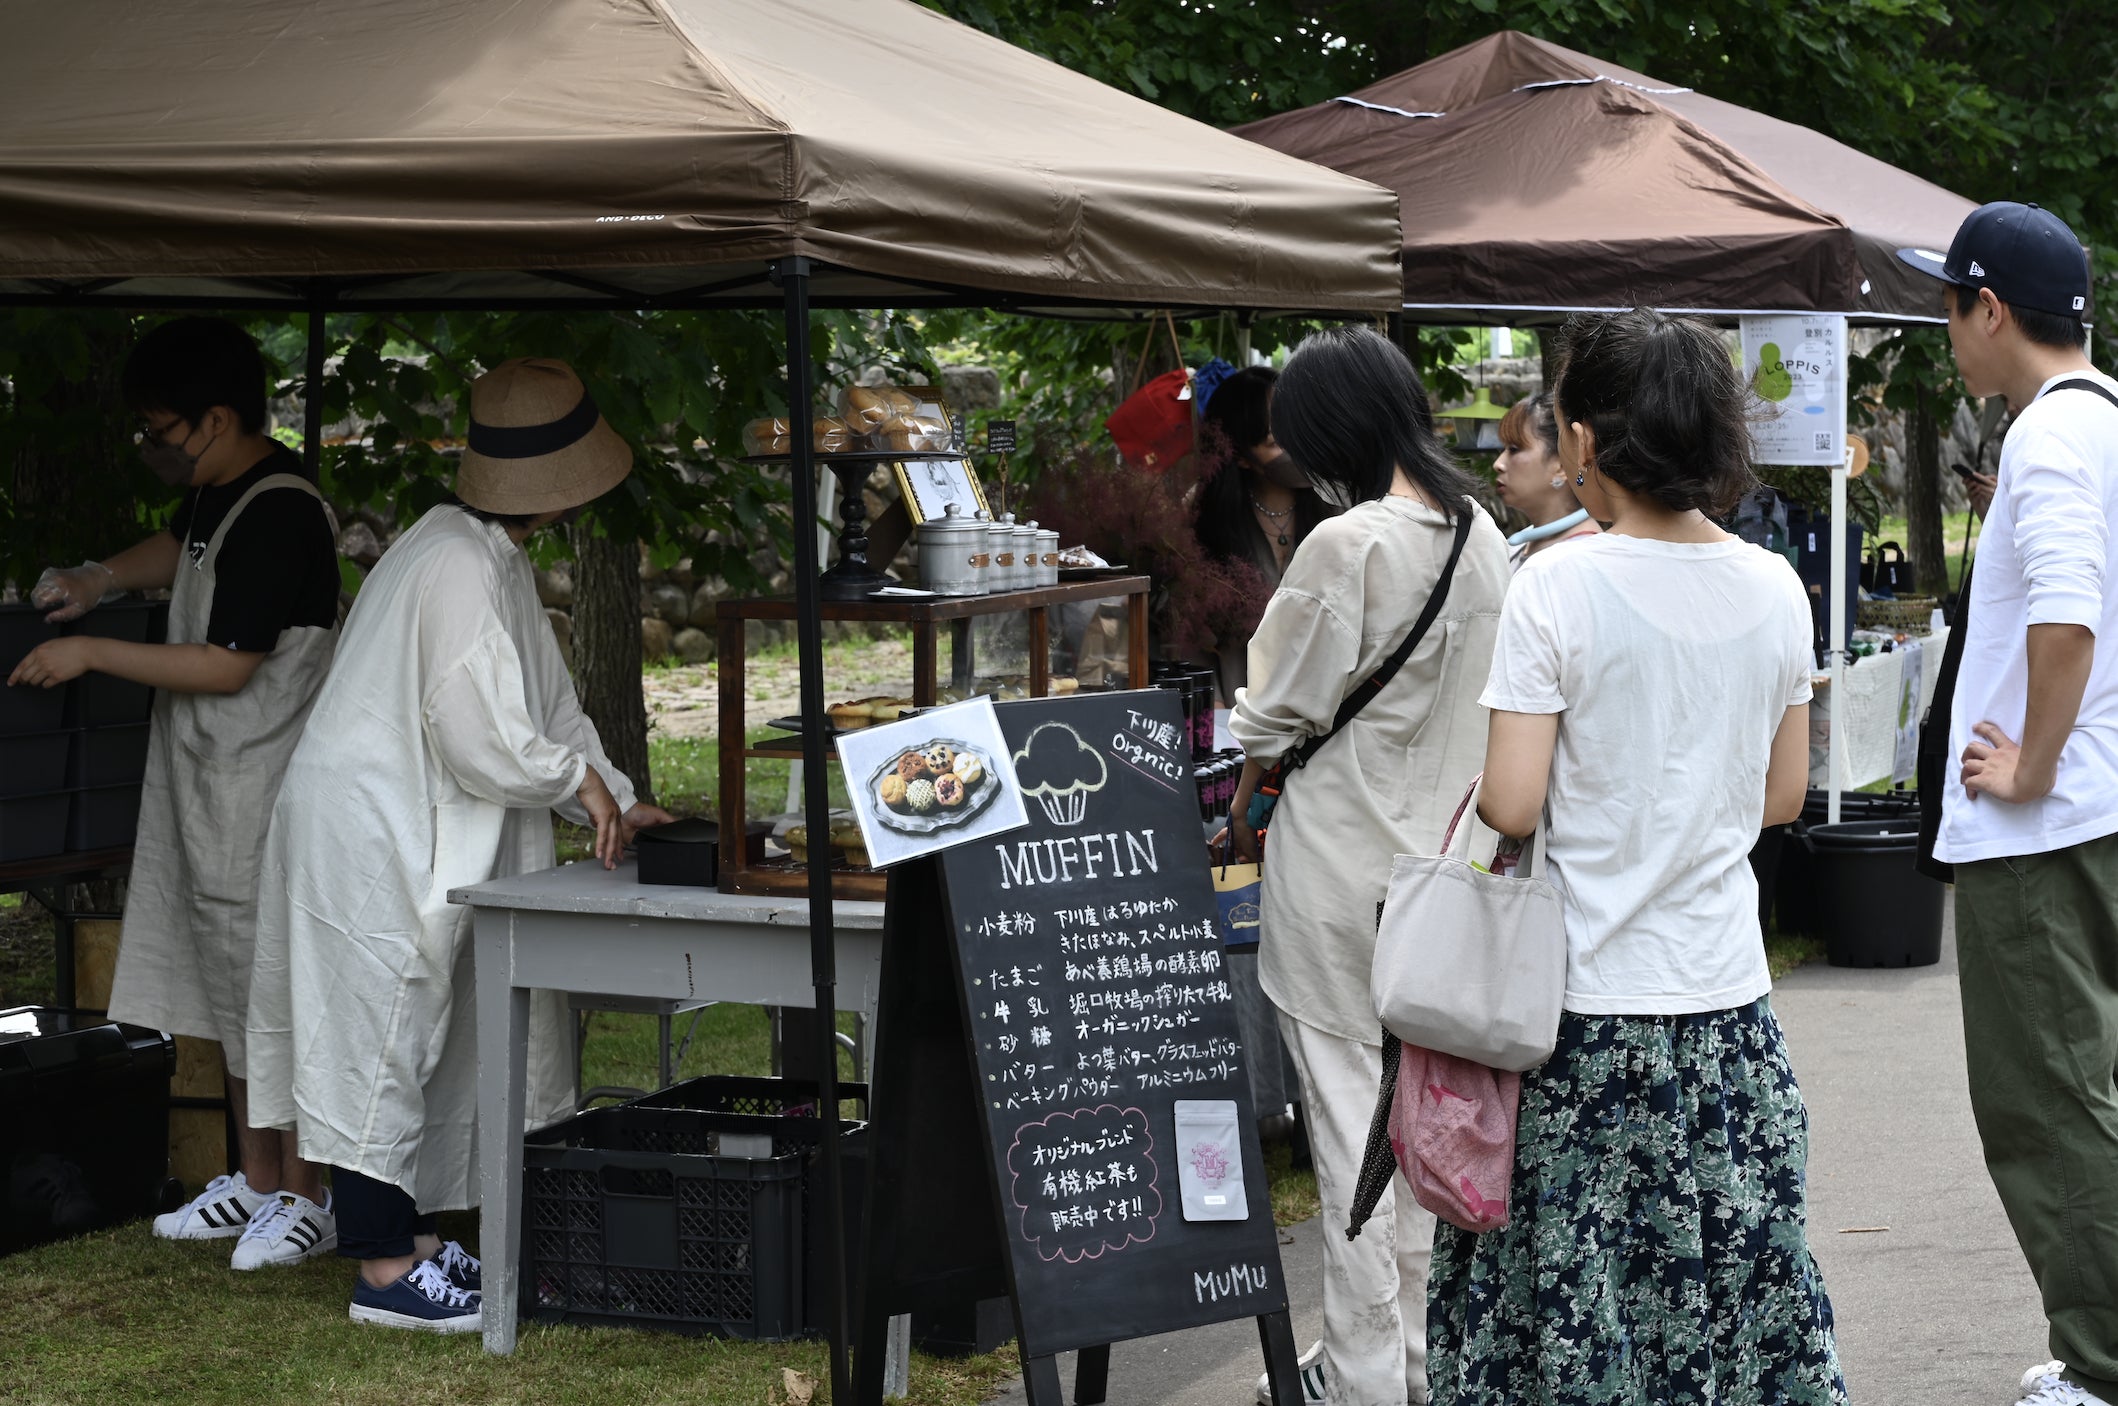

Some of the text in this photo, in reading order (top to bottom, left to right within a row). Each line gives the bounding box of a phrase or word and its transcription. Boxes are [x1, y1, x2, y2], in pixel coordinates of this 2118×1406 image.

[1765, 360, 1820, 376] LOPPIS
[1112, 733, 1183, 781] Orgnic!
[994, 829, 1159, 890] MUFFIN
[978, 910, 1037, 937] 小麦粉
[989, 963, 1044, 991] たまご
[1075, 1009, 1201, 1040] オーガニックシュガー
[1002, 1060, 1055, 1083] バター
[1006, 1074, 1120, 1111] ベーキングパウダー
[1042, 1161, 1138, 1201] 有機紅茶も
